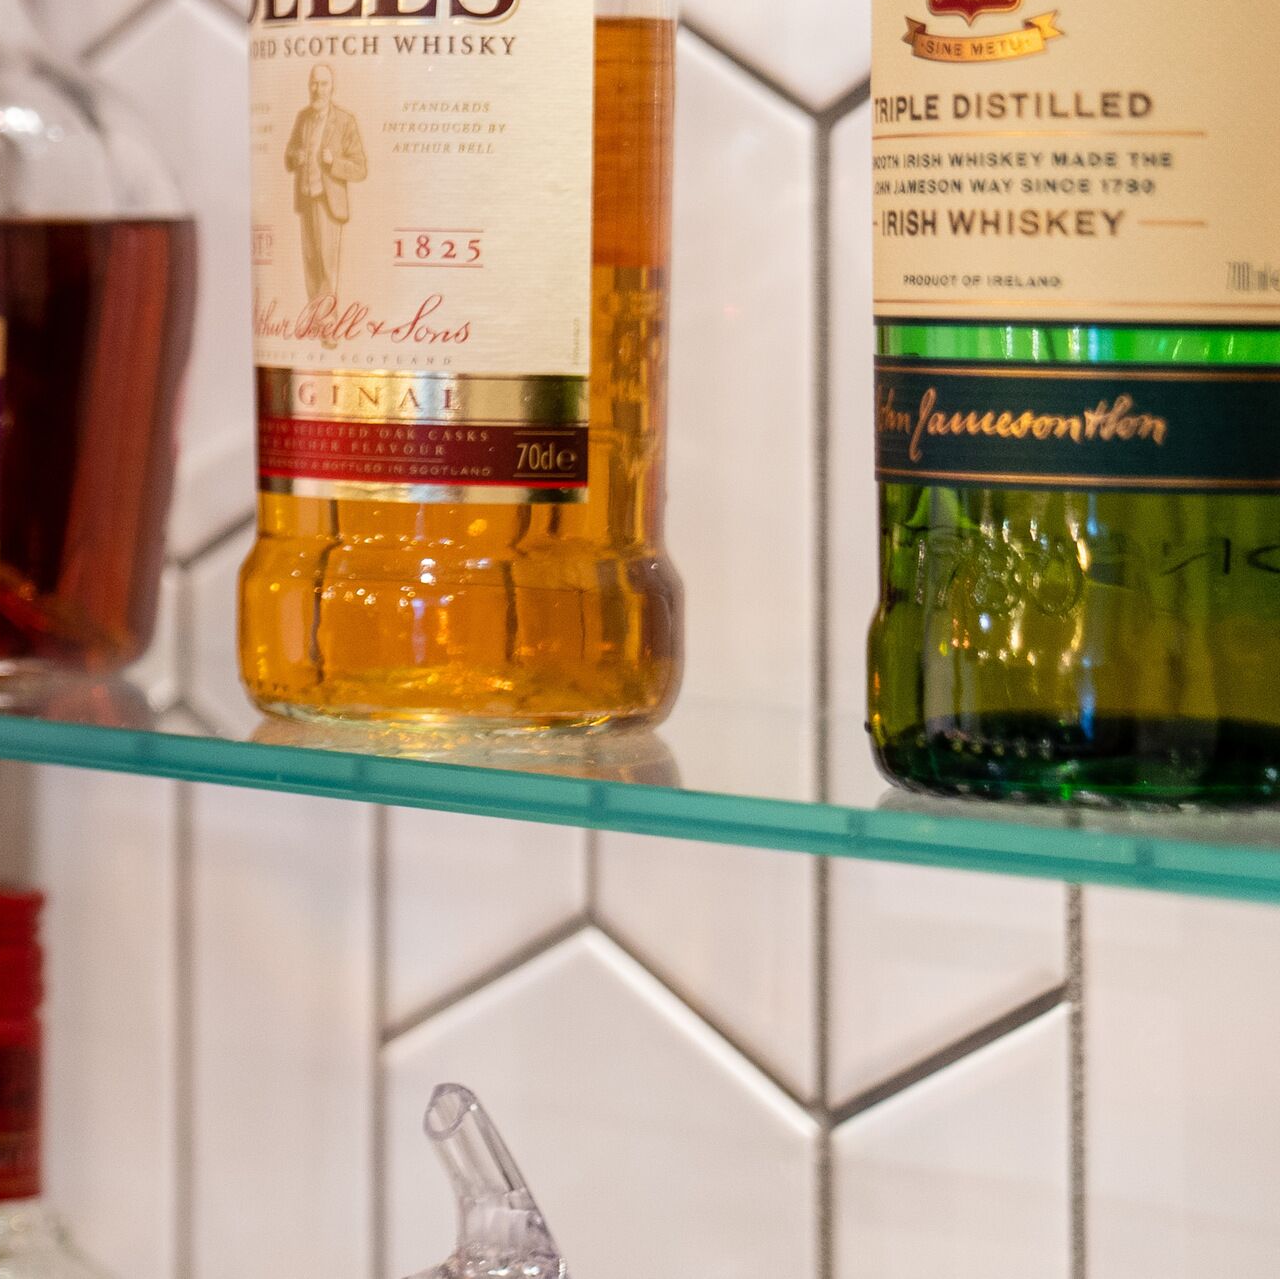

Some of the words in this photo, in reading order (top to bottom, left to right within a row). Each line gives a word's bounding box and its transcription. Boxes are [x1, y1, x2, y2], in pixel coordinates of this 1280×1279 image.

[284, 35, 380, 57] SCOTCH
[393, 34, 517, 57] WHISKY
[925, 39, 962, 56] SINE
[969, 36, 1023, 56] METU
[402, 101, 491, 113] STANDARDS
[874, 93, 940, 124] TRIPLE
[952, 91, 1153, 120] DISTILLED
[382, 122, 482, 134] INTRODUCED
[488, 123, 507, 133] BY
[392, 143, 451, 154] ARTHUR
[458, 144, 495, 154] BELL
[873, 153, 899, 171] OOTH
[903, 152, 942, 168] IRISH
[947, 151, 1042, 168] WHISKEY
[1051, 151, 1118, 168] MADE
[1127, 151, 1173, 168] THE
[875, 179, 891, 196] OHN
[893, 178, 963, 195] JAMESON
[969, 178, 1013, 194] WAY
[1020, 178, 1091, 194] SINCE
[1099, 178, 1156, 195] 1780
[881, 209, 937, 237] IRISH
[947, 209, 1126, 237] WHISKEY
[393, 234, 482, 263] 1825
[902, 274, 957, 287] PRODUCT
[962, 274, 981, 287] OF
[987, 275, 1062, 288] IRELAND
[294, 292, 370, 342] Bell
[389, 293, 473, 344] Sons
[340, 352, 453, 365] SCOTLAND
[281, 380, 465, 412] IGINAL
[877, 380, 911, 434] ohn
[379, 427, 417, 441] OAK
[427, 429, 489, 442] CASKS
[351, 440, 447, 457] FLAVOUR
[388, 463, 406, 474] IN
[409, 464, 491, 477] SCOTLAND
